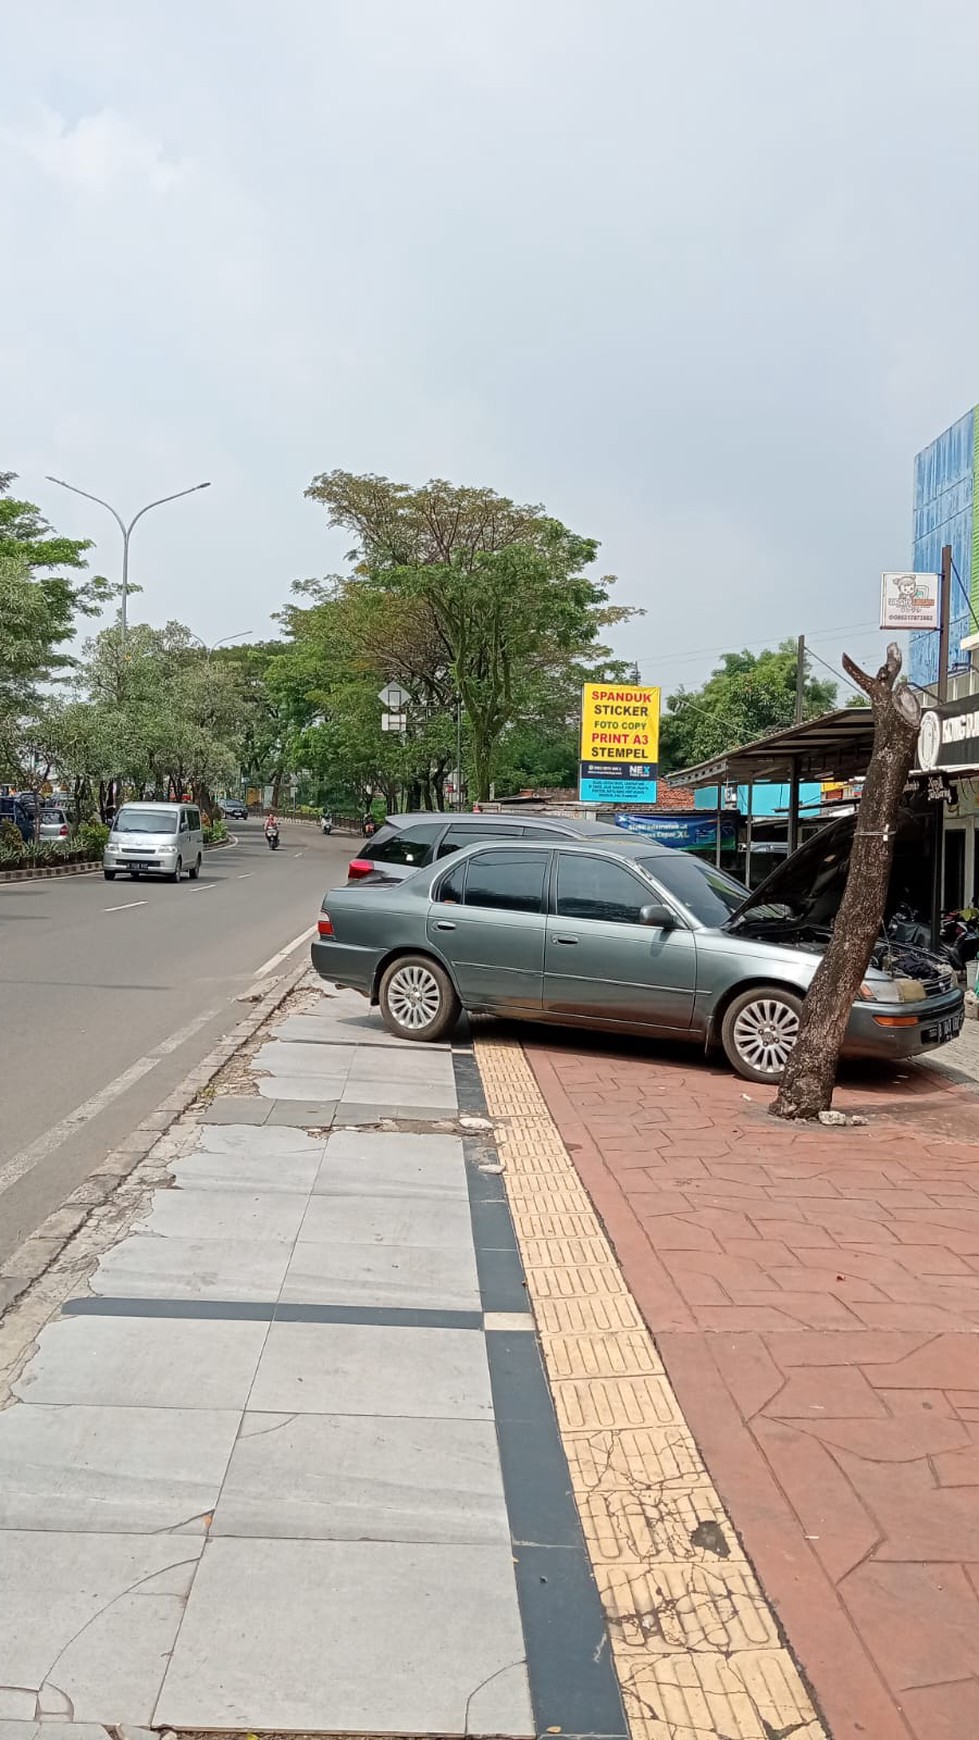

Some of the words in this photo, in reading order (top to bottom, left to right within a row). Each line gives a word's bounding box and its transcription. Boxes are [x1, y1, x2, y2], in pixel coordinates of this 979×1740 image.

[592, 691, 651, 703] SPANDUK
[594, 705, 648, 716] STICKER
[594, 720, 619, 729] FOTO
[621, 721, 647, 730] COPY
[591, 733, 629, 744] PRINT
[633, 734, 649, 745] A3
[591, 747, 648, 758] STEMPEL
[629, 765, 650, 774] NEX
